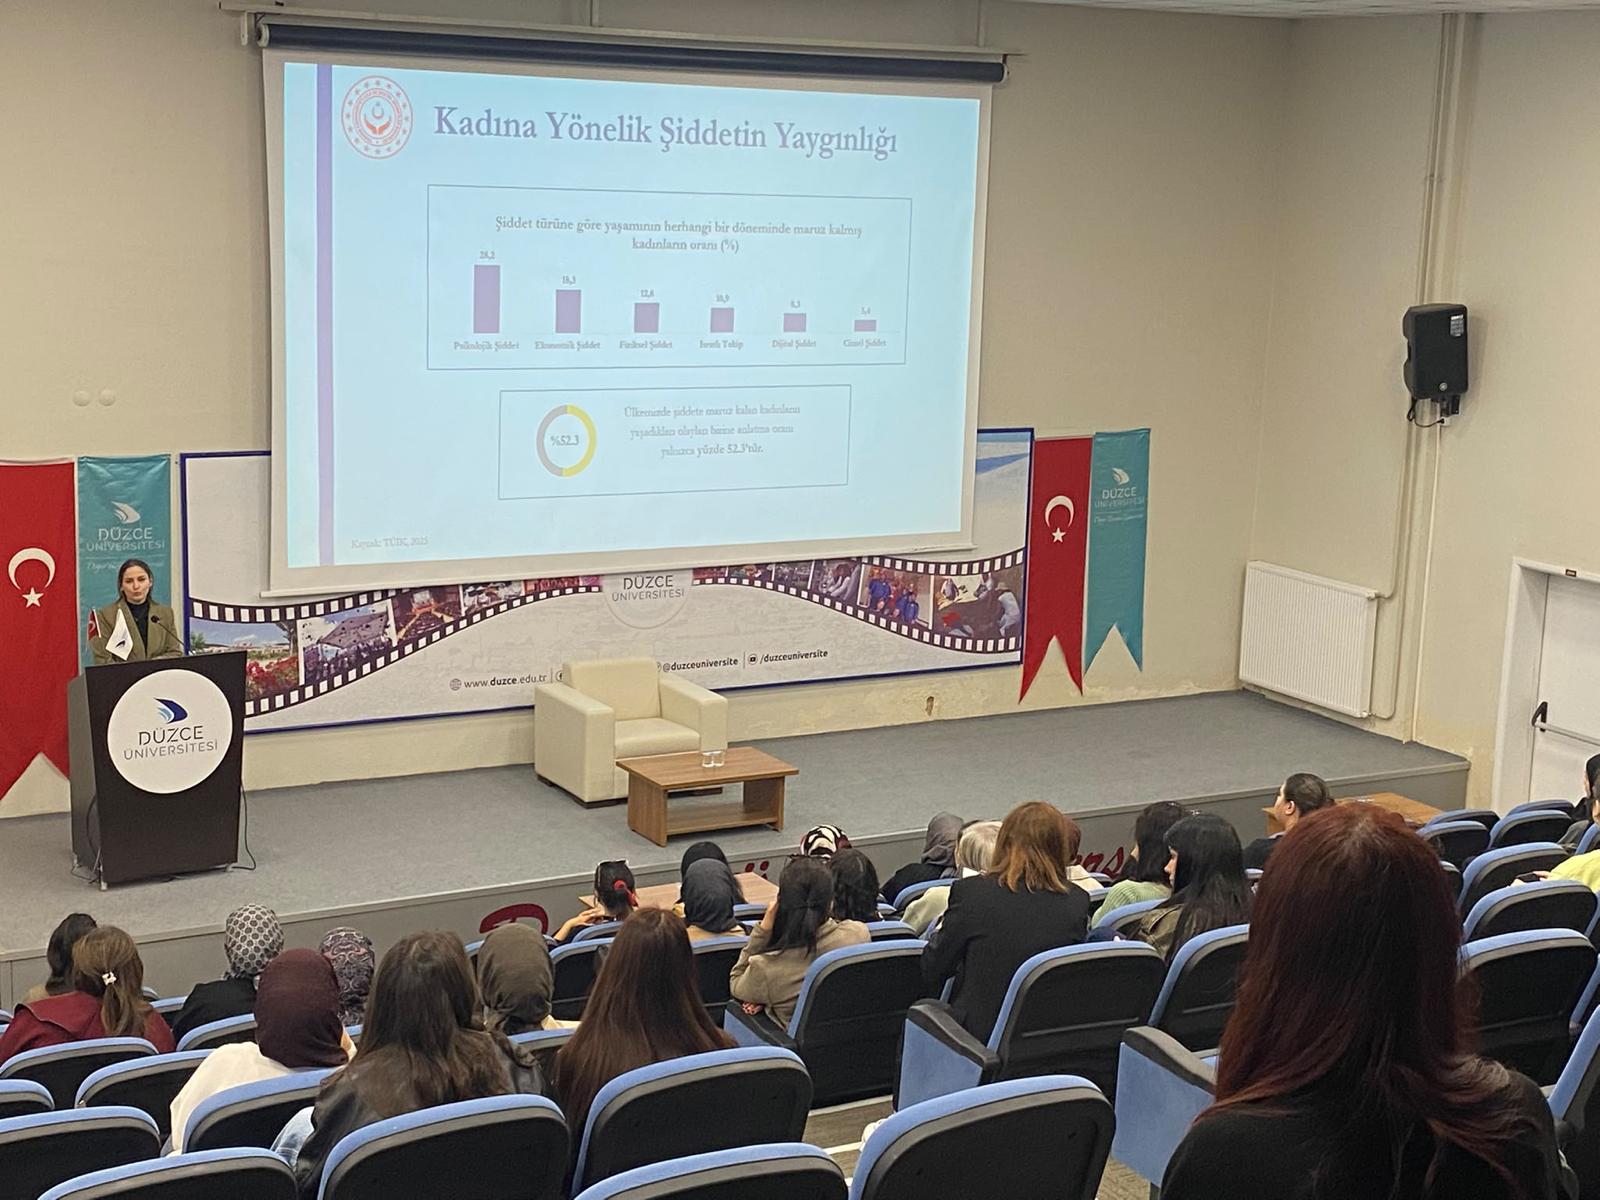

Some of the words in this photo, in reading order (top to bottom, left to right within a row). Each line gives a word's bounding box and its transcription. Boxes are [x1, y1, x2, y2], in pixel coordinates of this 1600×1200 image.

[433, 105, 537, 139] Kadına
[545, 111, 653, 143] Yönelik
[659, 116, 767, 153] Şiddetin
[774, 121, 898, 161] Yaygınlığı
[495, 216, 533, 232] Şiddet
[536, 217, 574, 230] türüne
[576, 218, 602, 234] göre
[604, 220, 661, 235] yaşamının
[664, 220, 712, 236] herhangi
[714, 221, 730, 233] bir
[732, 222, 791, 234] döneminde
[793, 225, 826, 235] maruz
[828, 224, 862, 238] kalmış
[632, 237, 687, 251] kadınların
[689, 239, 718, 251] oranı
[720, 238, 739, 254] (%)
[453, 341, 492, 352] Psikolojik
[494, 341, 520, 352] Şiddet
[535, 341, 576, 351] Ekonomik
[577, 341, 600, 352] Şiddet
[619, 340, 648, 350] Fiziksel
[649, 340, 672, 352] Şiddet
[673, 405, 704, 419] şiddete
[705, 407, 734, 416] maruz
[735, 405, 758, 415] kalan
[550, 435, 579, 446] %52.3
[696, 443, 725, 458] yüzde
[98, 526, 153, 541] DÜZCE
[86, 538, 165, 552] ÜNİVERSİTESİ
[623, 574, 673, 590] DÜZCE
[611, 588, 685, 602] ÜNİVERSİTESİ
[759, 649, 829, 664] /duzceuniversite
[663, 657, 739, 672] @duzceuniversite
[464, 673, 547, 688] www.duzce.edu.tr
[138, 724, 203, 746] DÜZCE
[123, 740, 218, 761] ÜNİVERSİTESİ
